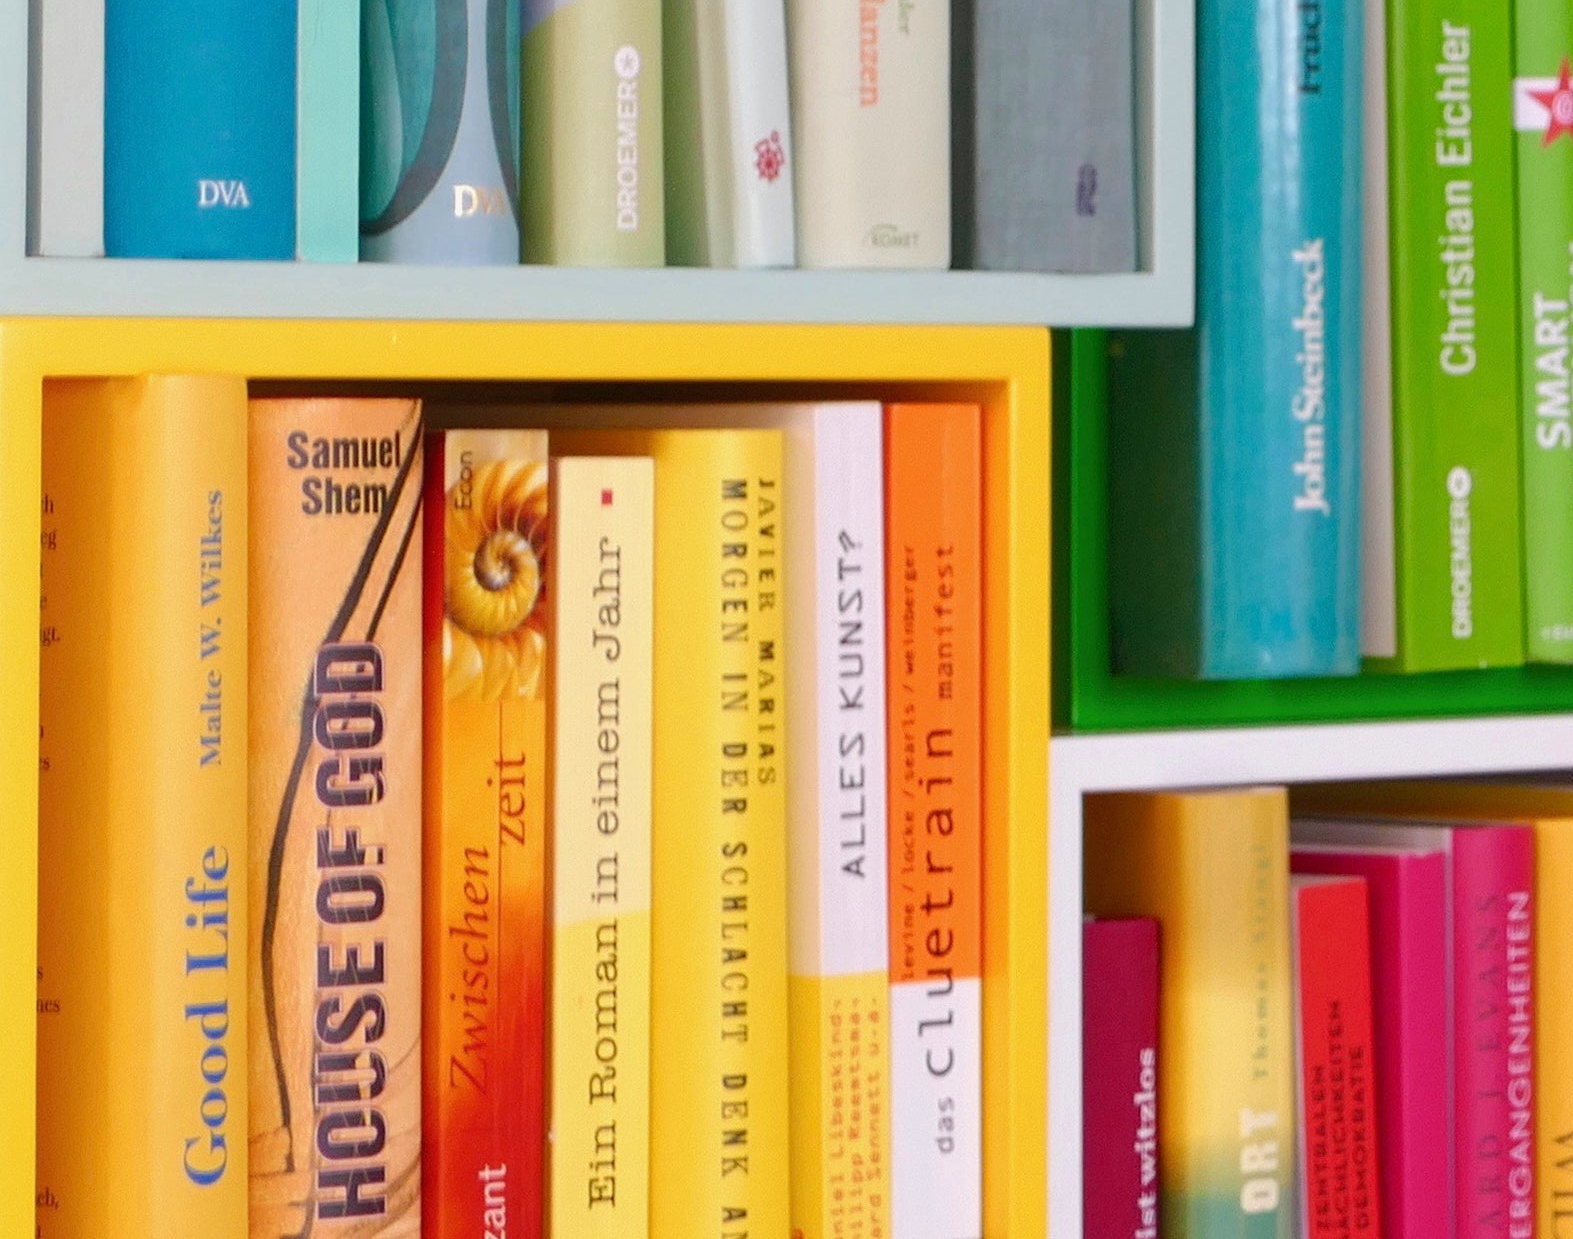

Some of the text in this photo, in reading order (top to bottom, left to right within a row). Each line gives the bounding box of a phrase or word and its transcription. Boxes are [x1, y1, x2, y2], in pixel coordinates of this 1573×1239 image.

[197, 179, 251, 209] DVA
[616, 81, 638, 232] DROEMER
[1436, 19, 1476, 376] Christian Eichler
[286, 429, 402, 470] Samuel
[300, 475, 390, 517] Shem
[454, 450, 474, 511] Econ
[1291, 237, 1329, 516] John Steinbeck
[1533, 291, 1572, 451] SMART
[199, 489, 223, 769] Malte W. Wilkes
[757, 477, 778, 786] JAVIER MARIAS
[838, 529, 867, 879] ALLES KUNST?
[314, 641, 388, 1222] HOUSE OF GOD
[588, 536, 622, 1211] Ein Roman in einem Jahr
[721, 478, 749, 1178] MORGEN IN DER SCHLACHT DENK
[919, 543, 955, 1154] das Cluetrain manifest
[184, 844, 230, 1188] Good Life
[449, 845, 491, 1097] Zwischen
[1134, 1047, 1157, 1186] witzlos
[1239, 1107, 1281, 1215] ORT
